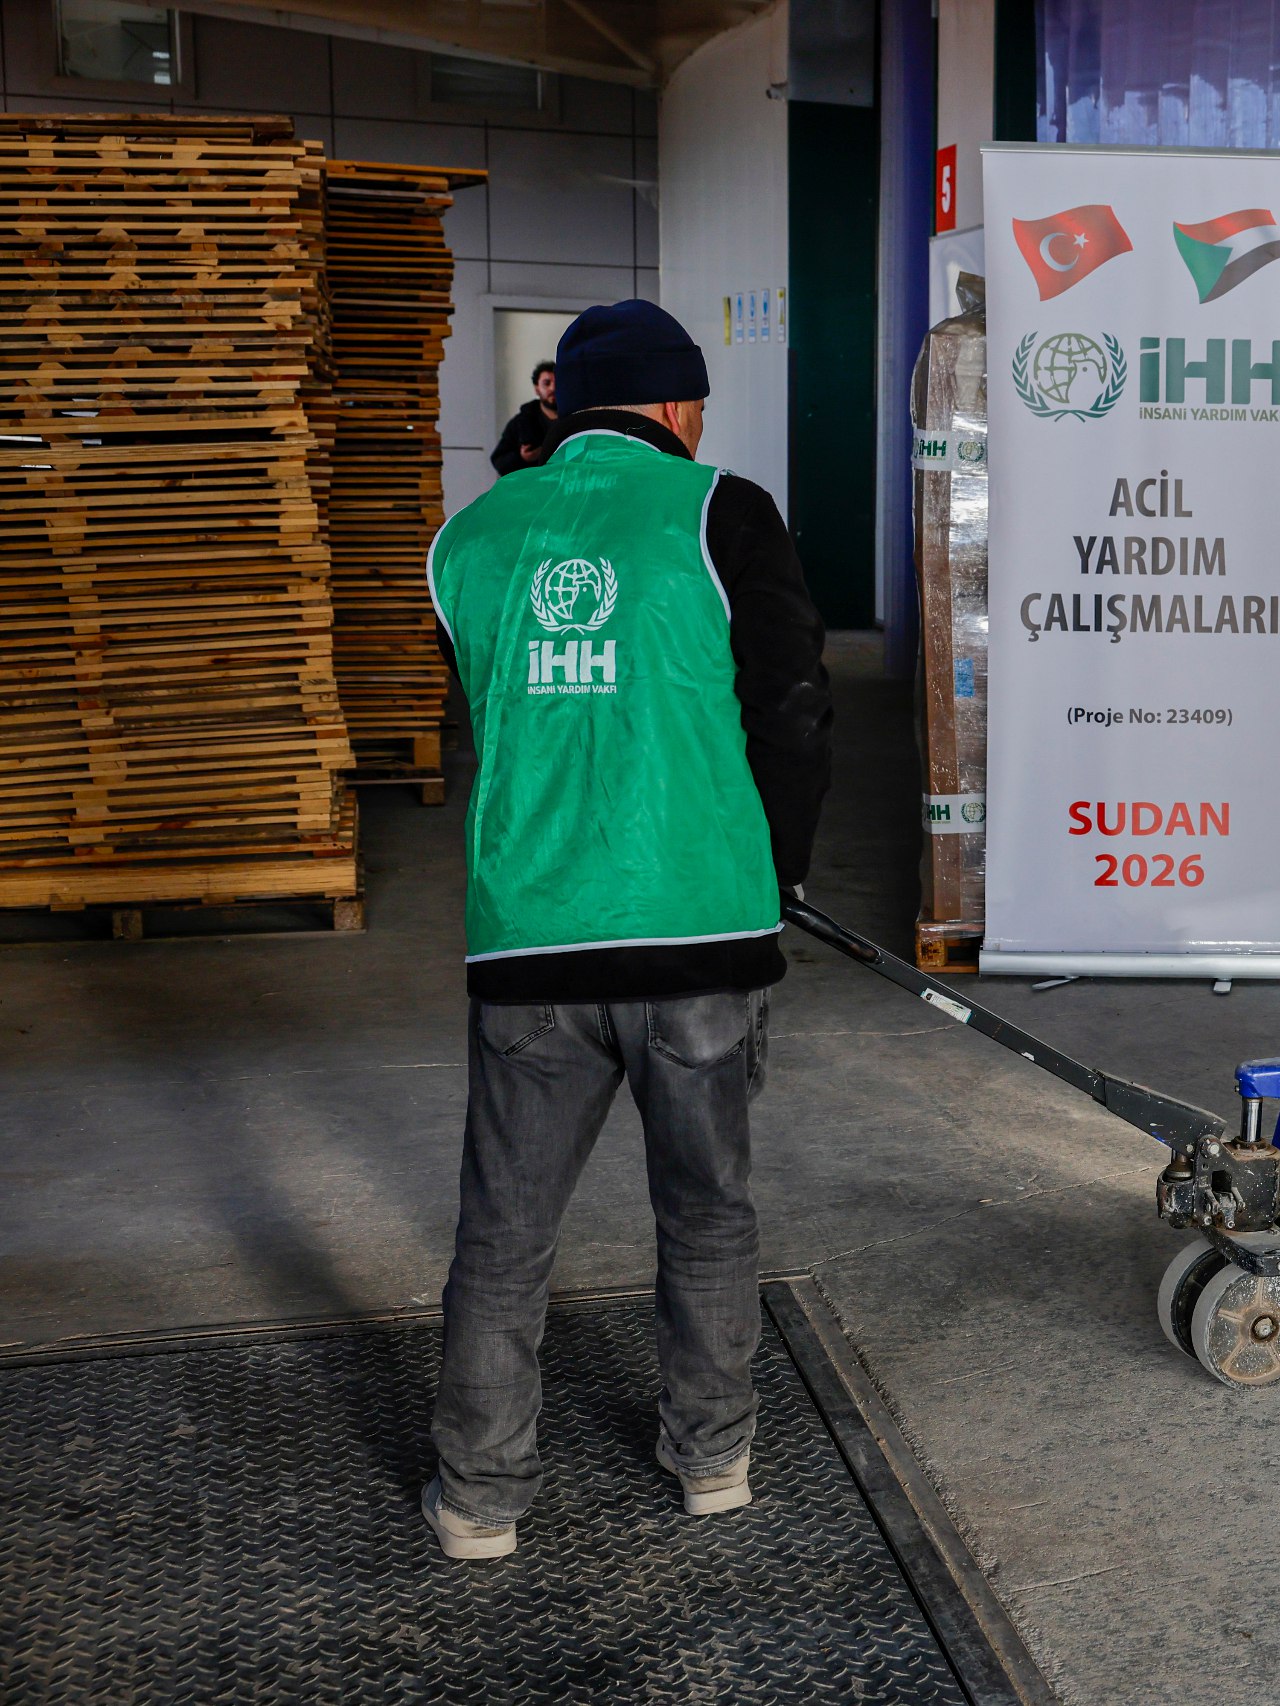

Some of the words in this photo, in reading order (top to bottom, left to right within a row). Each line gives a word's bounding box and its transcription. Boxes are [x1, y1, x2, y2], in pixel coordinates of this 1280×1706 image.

[942, 165, 951, 214] 5
[1190, 408, 1247, 422] YARDIM
[1108, 469, 1193, 518] ACİL
[1072, 535, 1226, 576] YARDIM
[1020, 592, 1279, 643] ÇALIŞMALARI
[593, 684, 617, 694] VAKFI
[1067, 707, 1124, 728] (Proje
[1129, 708, 1162, 724] No:
[1166, 709, 1233, 727] 23409)
[1068, 801, 1230, 837] SUDAN
[1094, 853, 1205, 888] 2026
